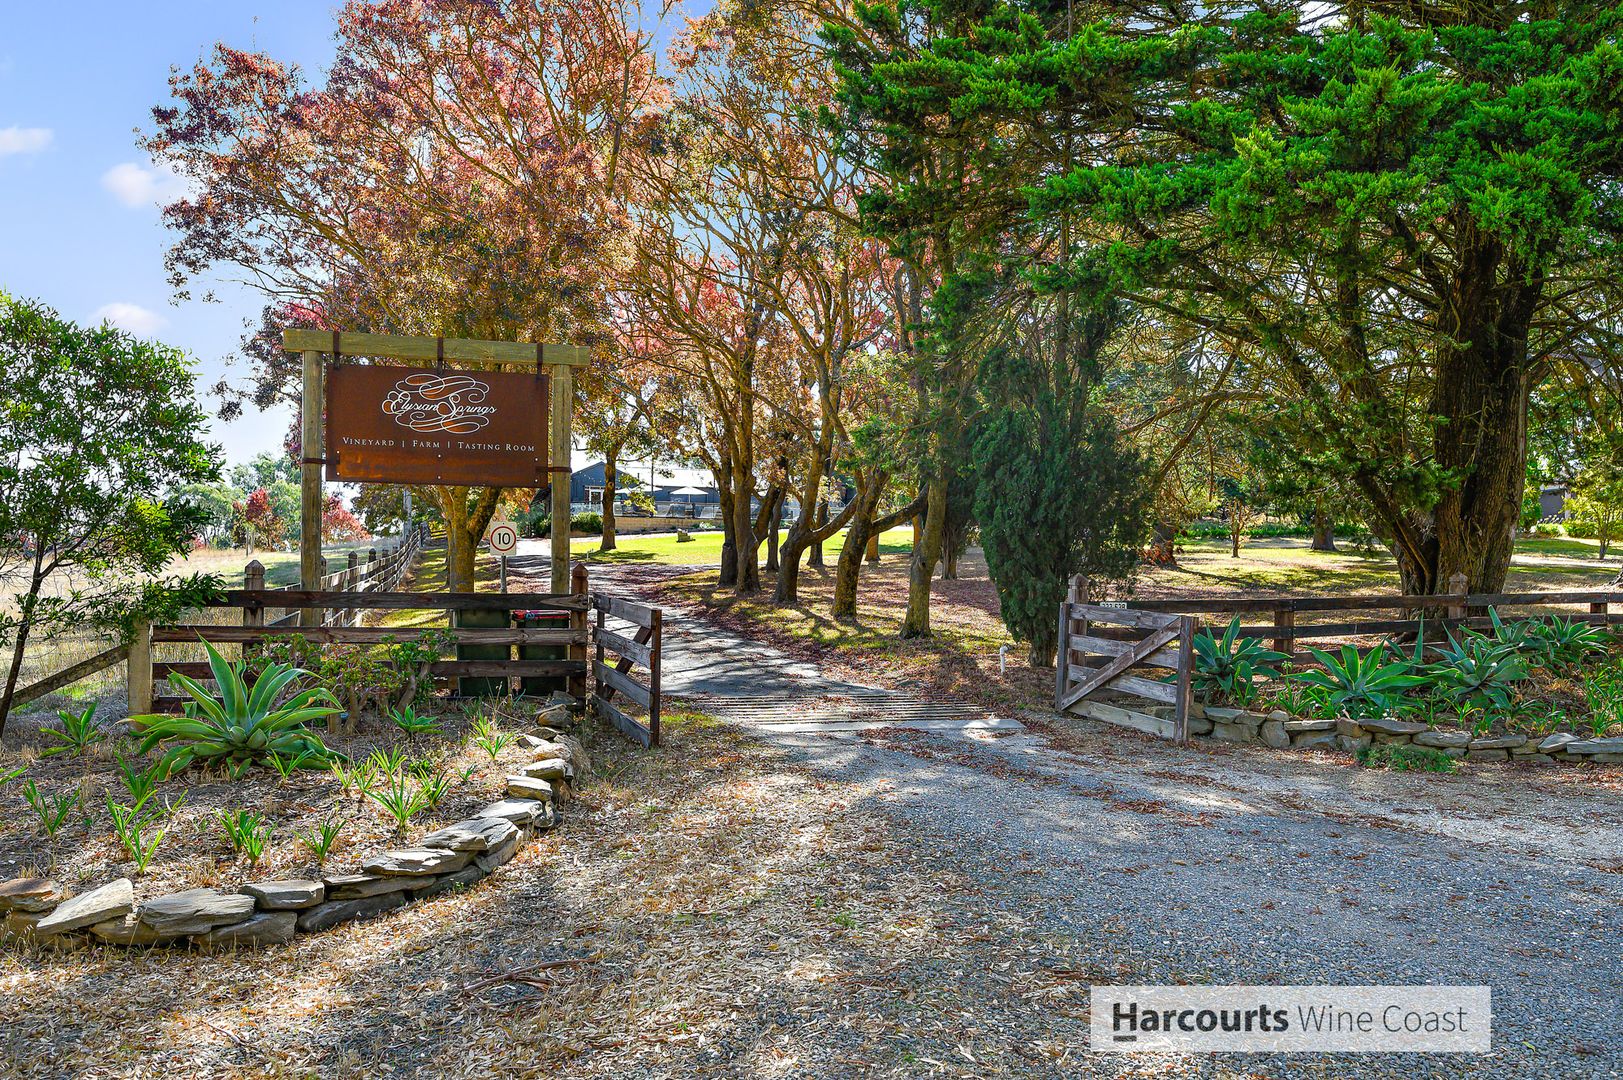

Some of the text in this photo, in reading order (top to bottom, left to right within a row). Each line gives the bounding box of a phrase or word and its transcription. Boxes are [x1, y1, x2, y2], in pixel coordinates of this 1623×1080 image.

[382, 391, 497, 418] Elysian Springs
[342, 437, 535, 452] VINEYARD FARM TASTING ROOM
[497, 532, 511, 545] 10
